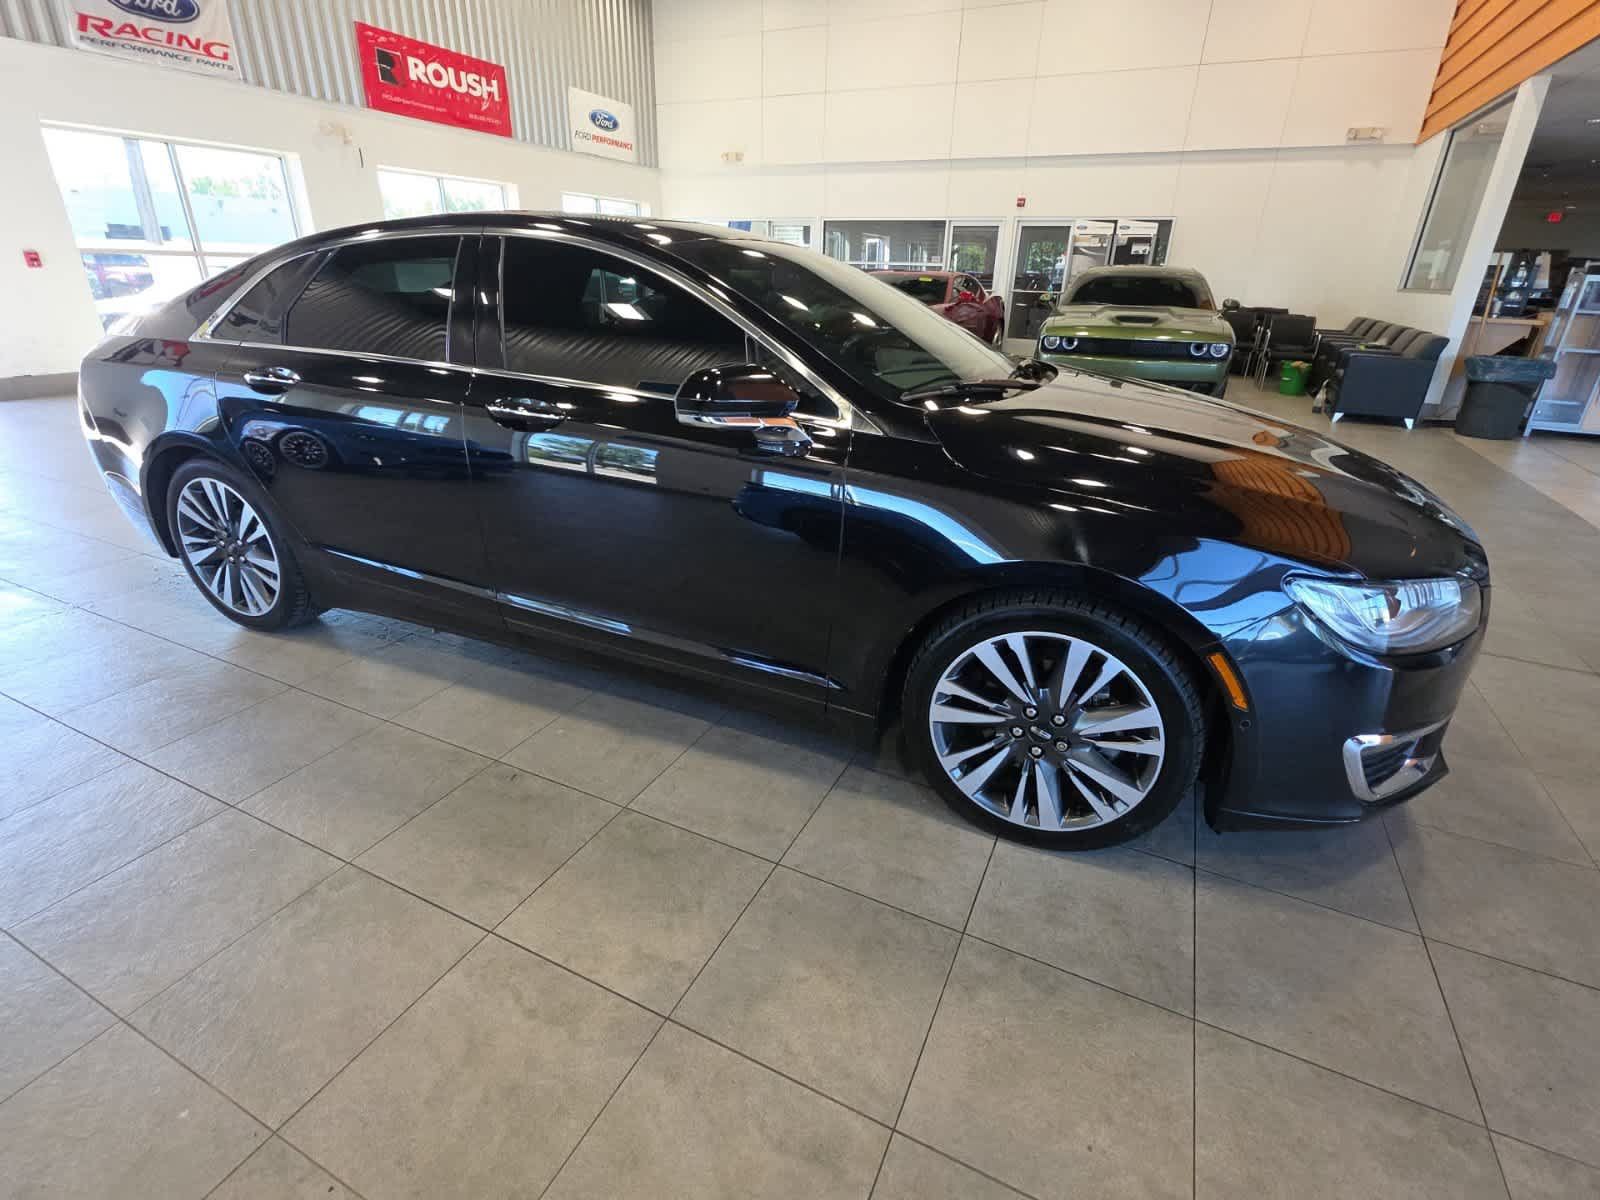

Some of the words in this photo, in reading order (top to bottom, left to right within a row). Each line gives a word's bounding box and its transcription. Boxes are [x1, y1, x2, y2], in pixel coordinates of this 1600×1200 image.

[120, 0, 180, 16] ord
[75, 12, 231, 61] RACING
[79, 35, 192, 63] PERFORMANCE
[196, 58, 234, 71] PARTS
[406, 55, 502, 102] ROUSH
[595, 112, 614, 129] Ford
[574, 129, 592, 141] FORD
[592, 134, 633, 152] PERFORMANCE
